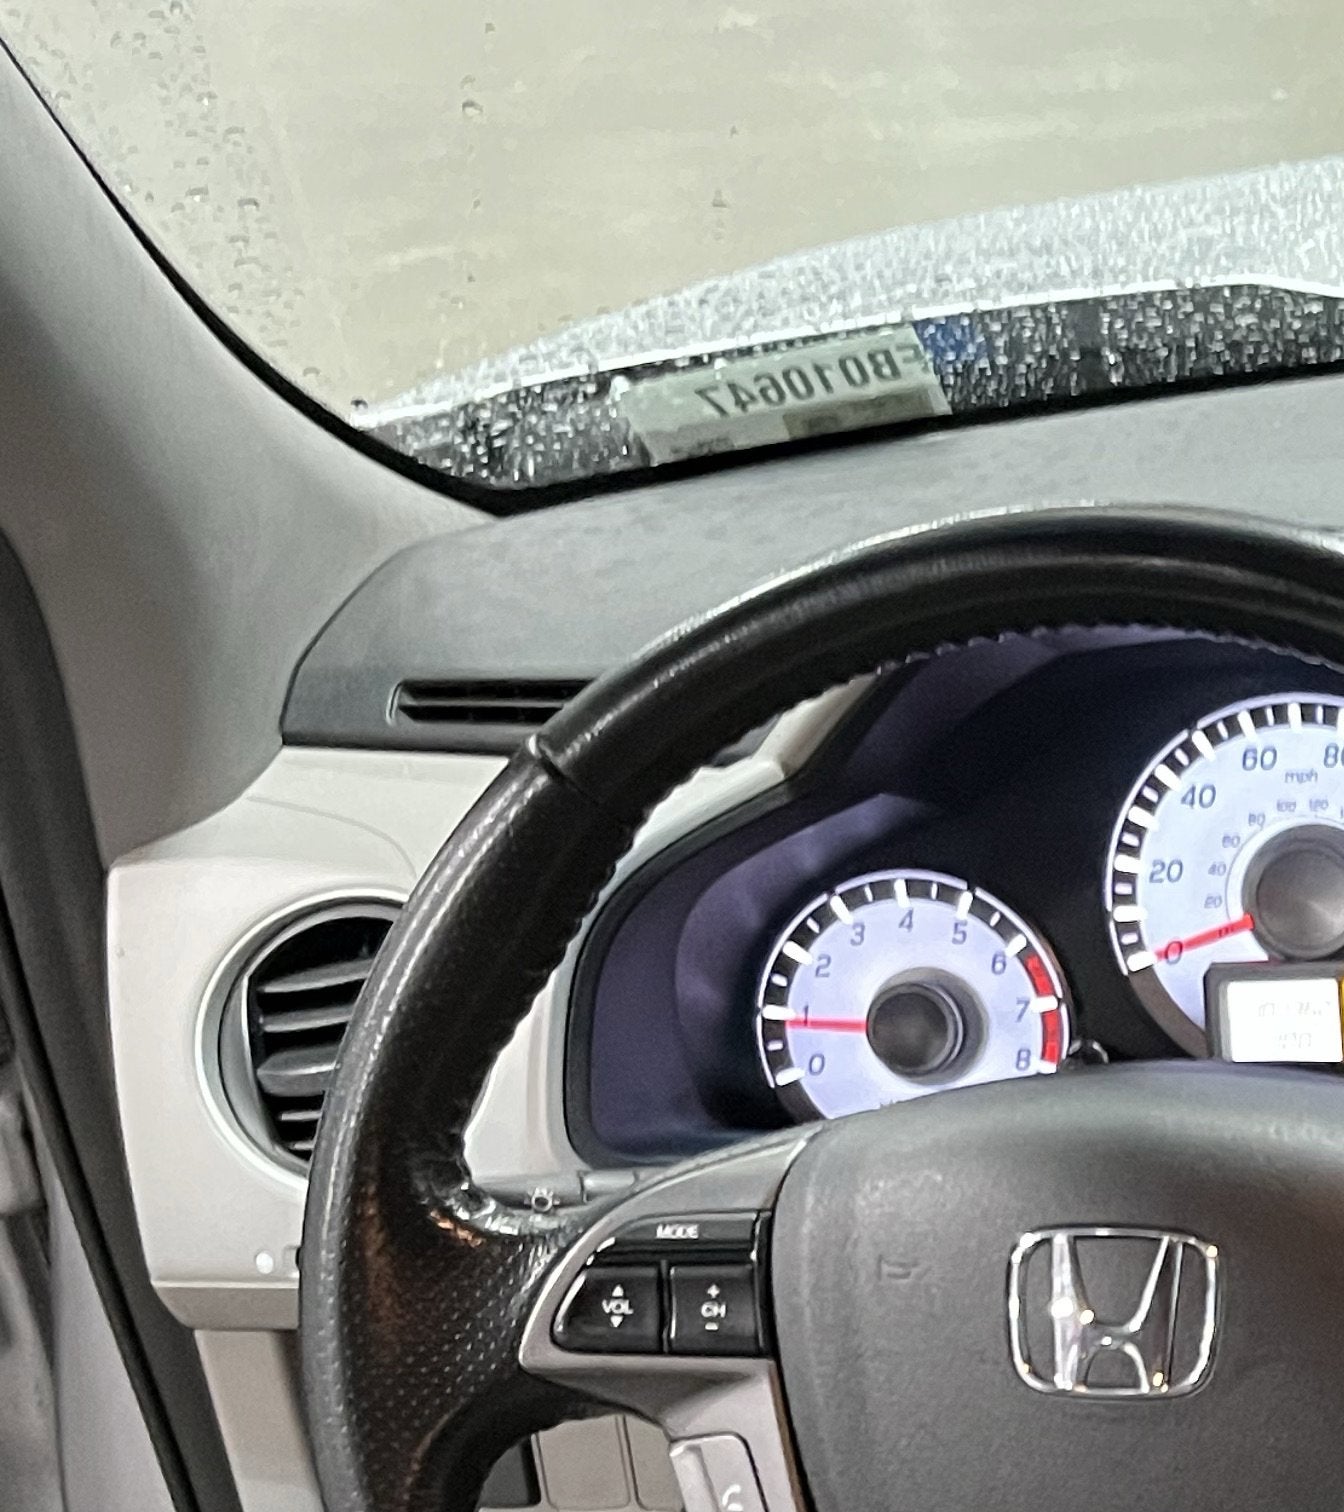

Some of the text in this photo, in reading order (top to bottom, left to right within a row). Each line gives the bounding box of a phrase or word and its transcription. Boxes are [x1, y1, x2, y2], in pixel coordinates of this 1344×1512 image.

[1242, 747, 1277, 771] 60
[1284, 768, 1318, 784] mph
[1180, 784, 1217, 809] 40
[1149, 859, 1184, 883] 20
[898, 909, 914, 932] 4
[849, 922, 866, 947] 3
[951, 922, 968, 945] 5
[991, 950, 1007, 975] 6
[1164, 940, 1183, 964] 0
[815, 953, 832, 978] 2
[802, 1005, 810, 1027] 1
[1015, 997, 1031, 1022] 7
[809, 1053, 825, 1076] 0
[1015, 1048, 1032, 1072] 8
[656, 1224, 699, 1239] MODE
[602, 1299, 634, 1315] VOL
[701, 1301, 727, 1318] CH
